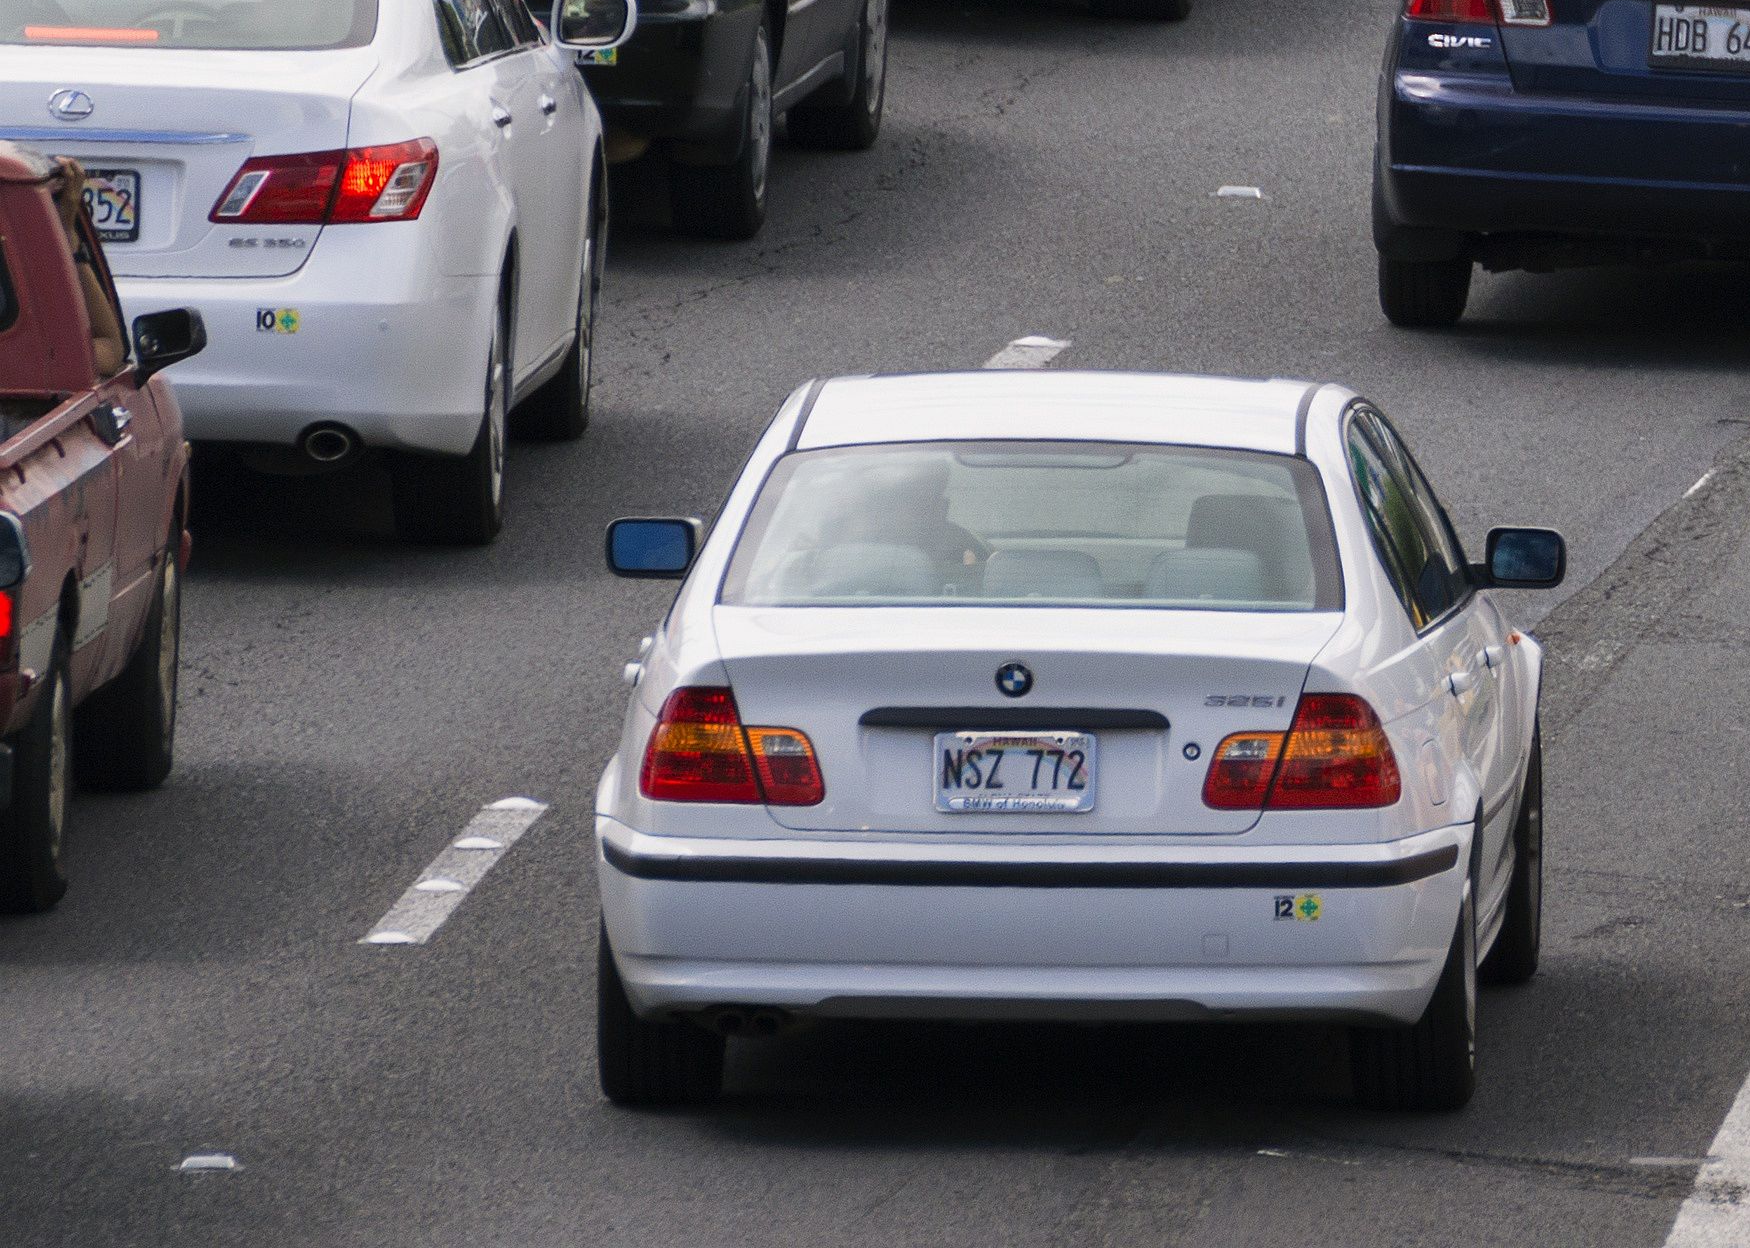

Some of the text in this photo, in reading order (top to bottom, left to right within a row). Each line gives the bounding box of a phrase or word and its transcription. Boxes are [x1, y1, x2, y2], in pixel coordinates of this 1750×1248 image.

[1428, 33, 1491, 48] CIVIC
[1657, 18, 1708, 53] HDB
[256, 310, 275, 329] 10
[942, 749, 1086, 790] NSZ 772
[1275, 899, 1293, 917] 12
